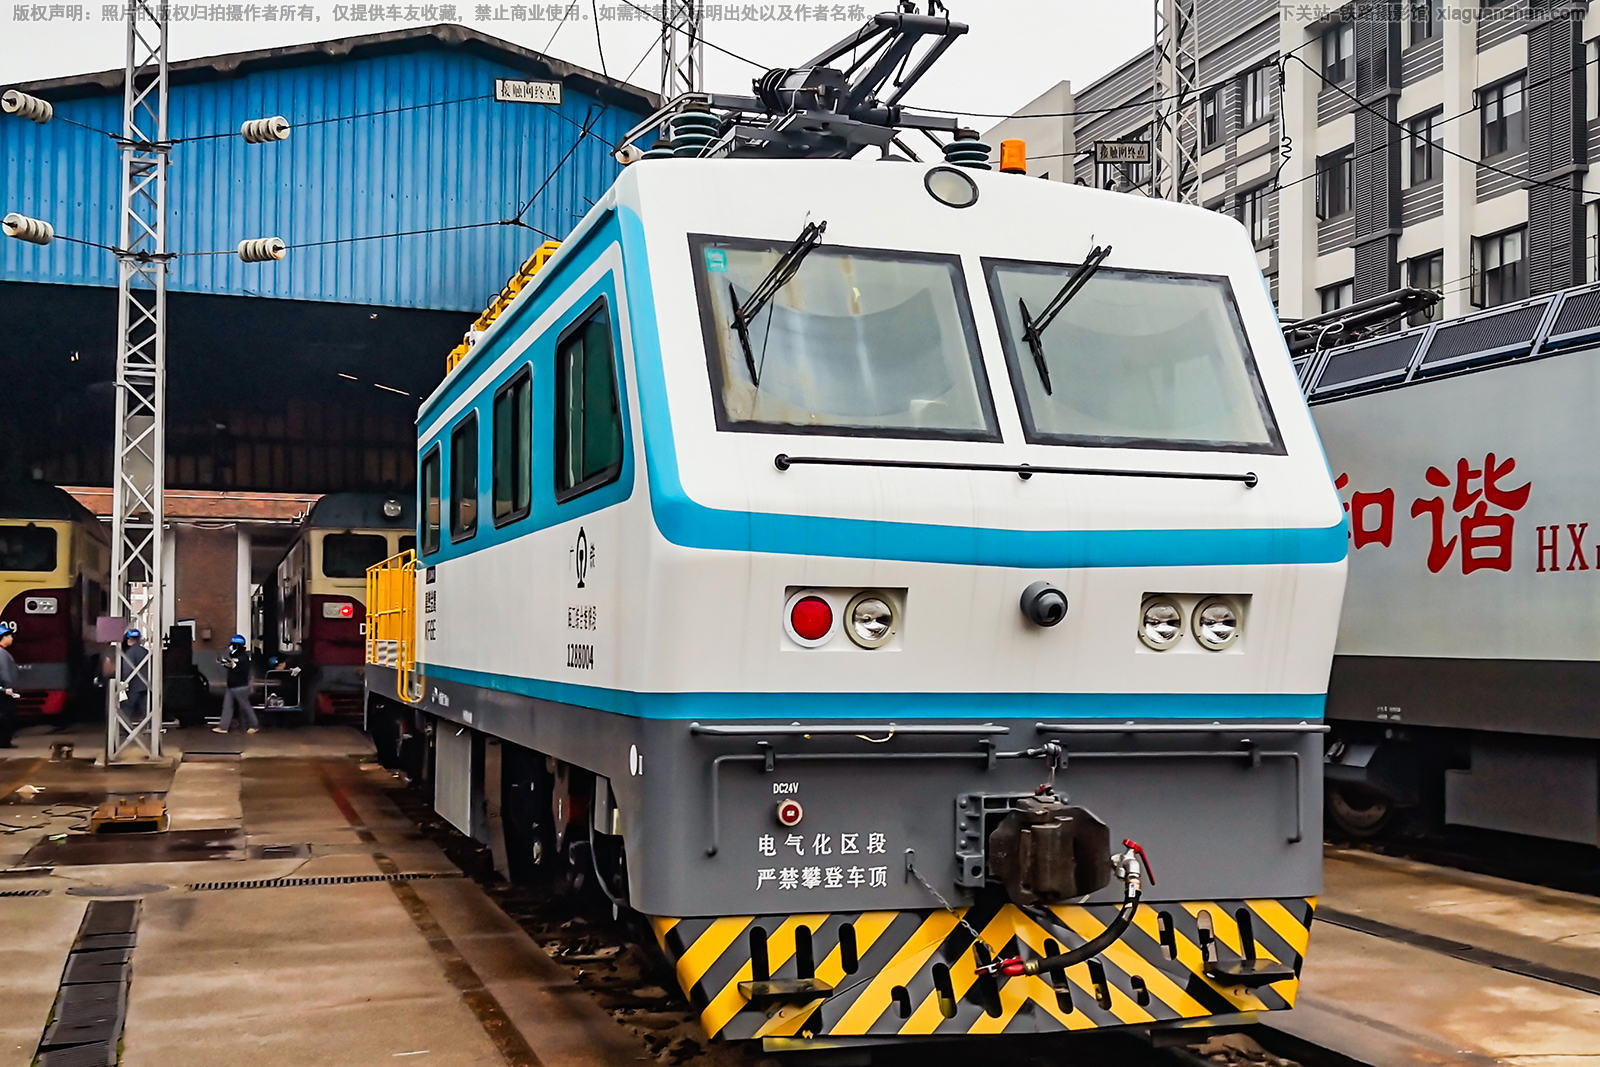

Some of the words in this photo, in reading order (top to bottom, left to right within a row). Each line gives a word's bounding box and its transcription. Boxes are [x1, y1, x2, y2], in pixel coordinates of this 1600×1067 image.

[1536, 523, 1600, 573] HX
[772, 782, 799, 795] DC24V
[758, 832, 888, 857] 电气化区段
[756, 866, 889, 891] 严禁攀登车顶
